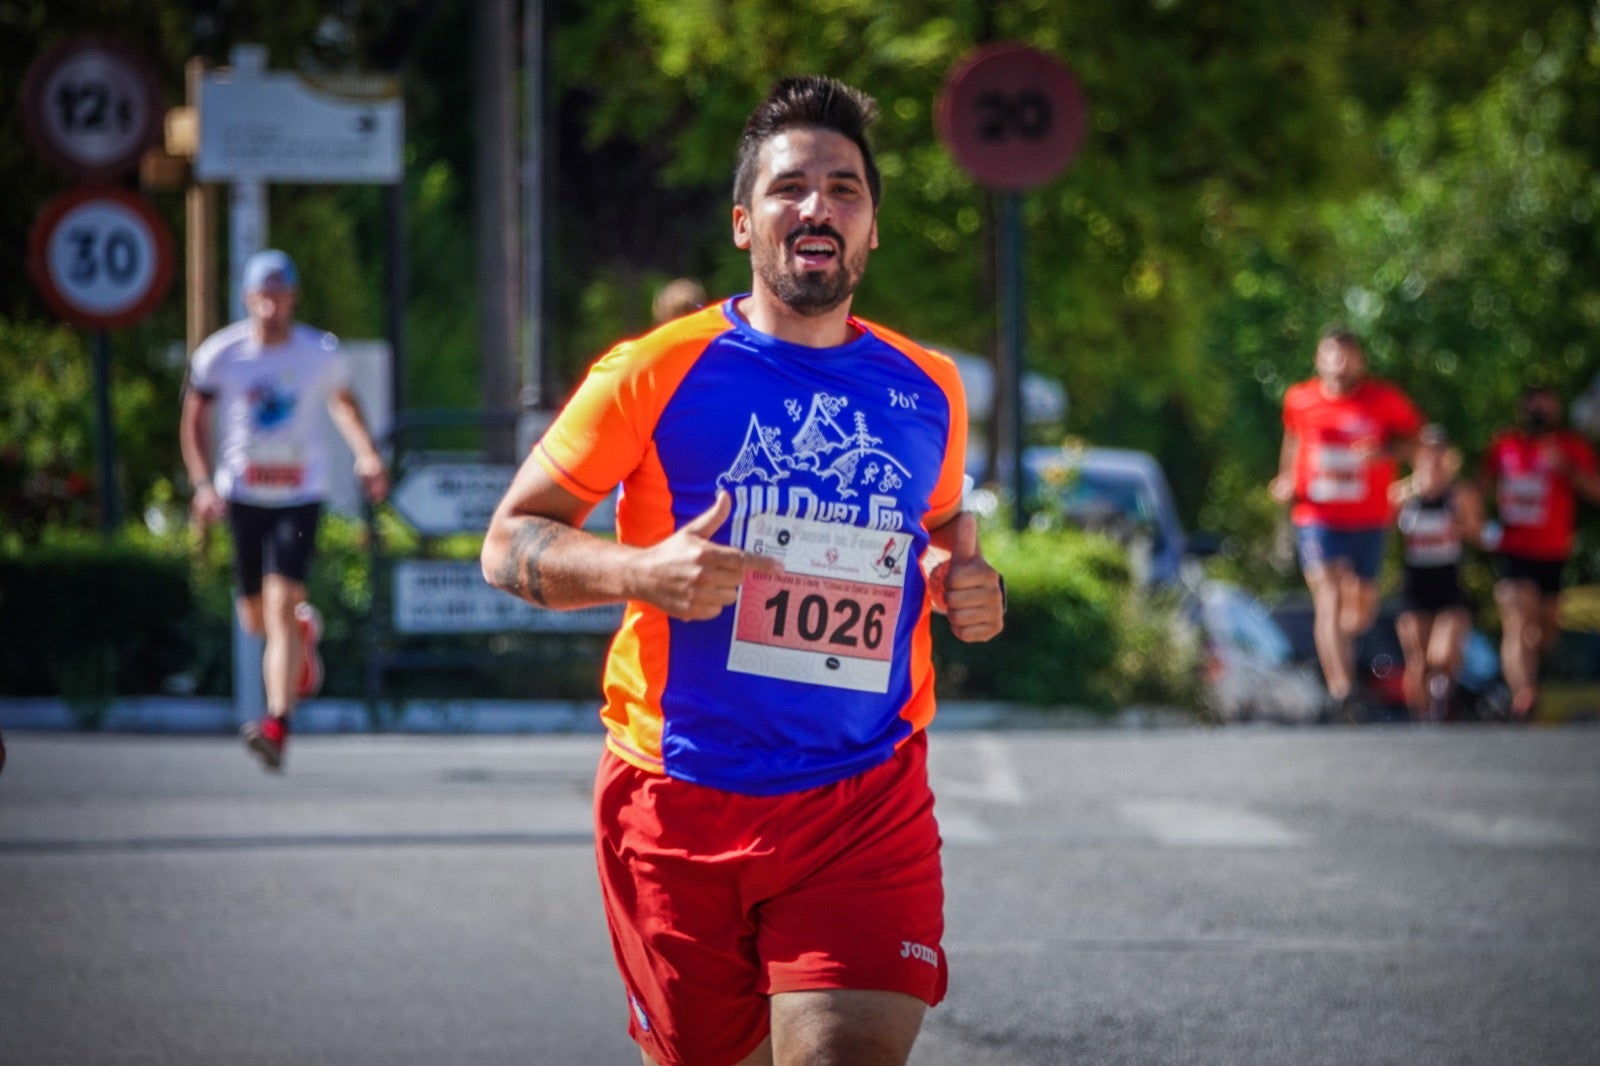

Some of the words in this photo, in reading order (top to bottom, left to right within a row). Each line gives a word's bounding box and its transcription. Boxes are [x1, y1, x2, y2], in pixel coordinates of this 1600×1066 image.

[975, 89, 1054, 144] 20
[68, 227, 139, 289] 30
[765, 589, 886, 650] 1026
